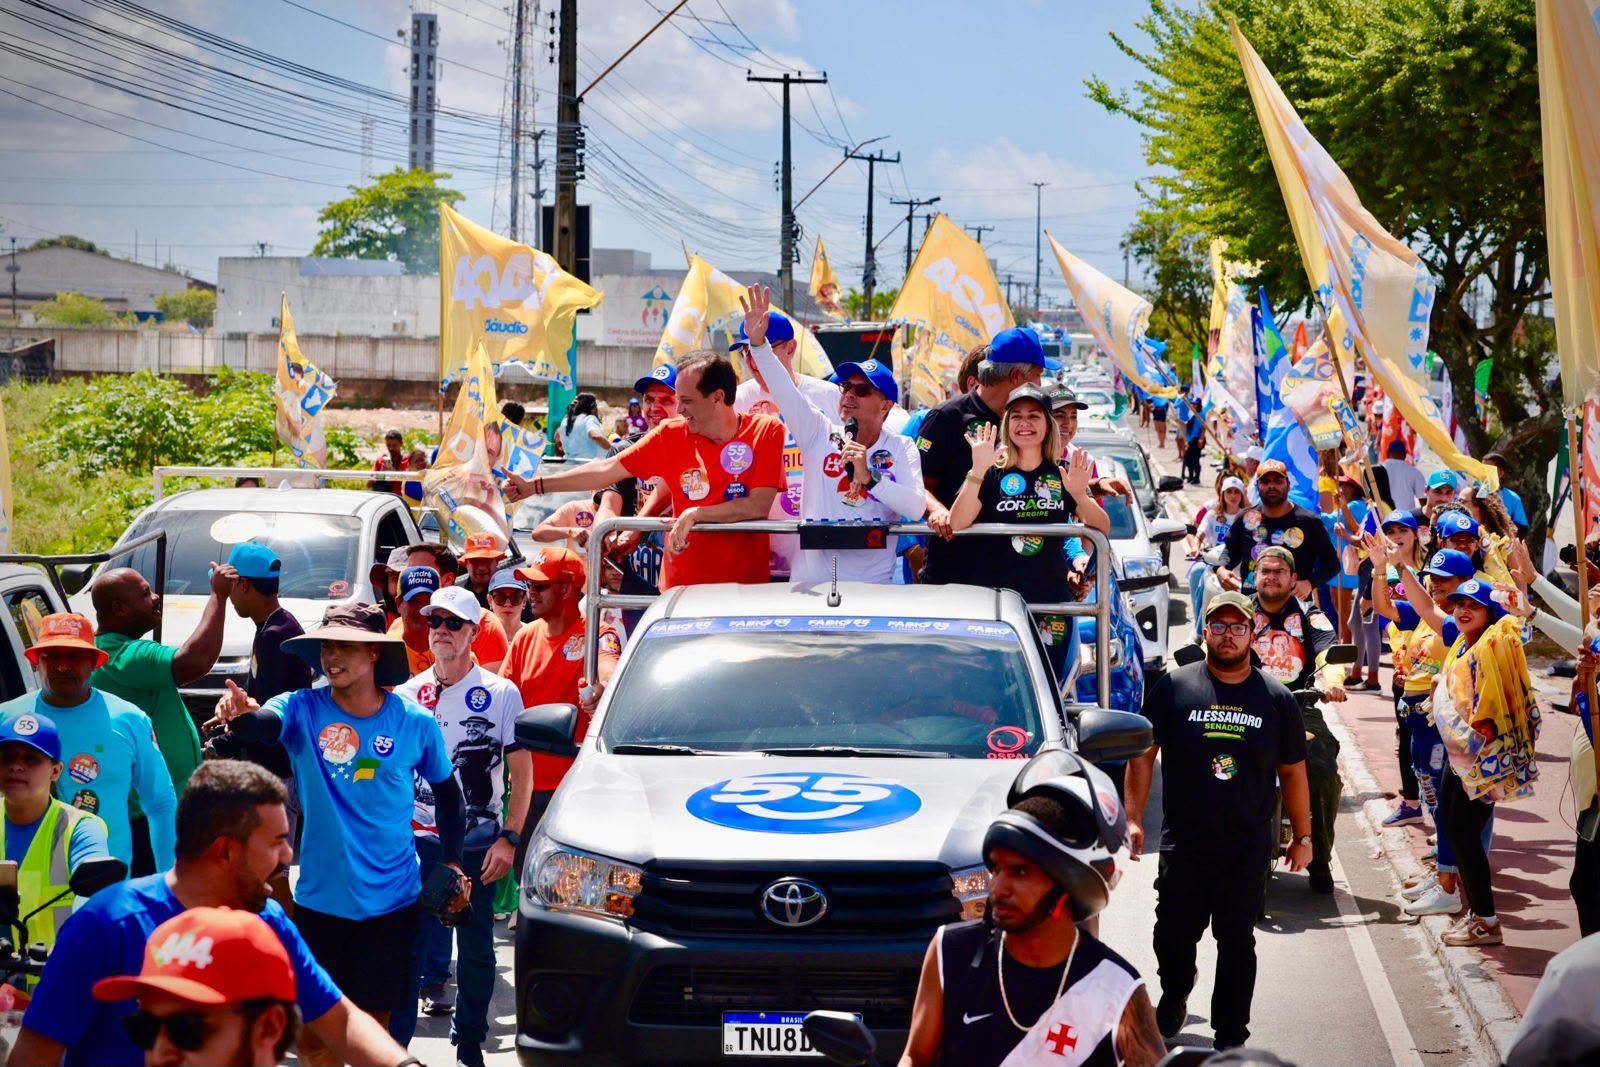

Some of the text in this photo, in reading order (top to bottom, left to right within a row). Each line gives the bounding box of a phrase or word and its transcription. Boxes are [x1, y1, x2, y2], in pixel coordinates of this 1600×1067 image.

[728, 445, 747, 456] 55
[996, 498, 1064, 511] CORAGEM
[1016, 510, 1049, 518] SERGIPE
[408, 570, 432, 579] André
[408, 577, 433, 585] Moura
[1466, 583, 1478, 591] 55
[470, 695, 486, 705] 55
[1210, 704, 1243, 712] DELEGADO
[1187, 709, 1263, 729] ALESSANDRO
[17, 719, 35, 731] 55
[1204, 722, 1245, 733] SENADOR
[373, 735, 394, 749] 55
[710, 776, 896, 803] 55
[734, 1026, 814, 1052] TNU8D
